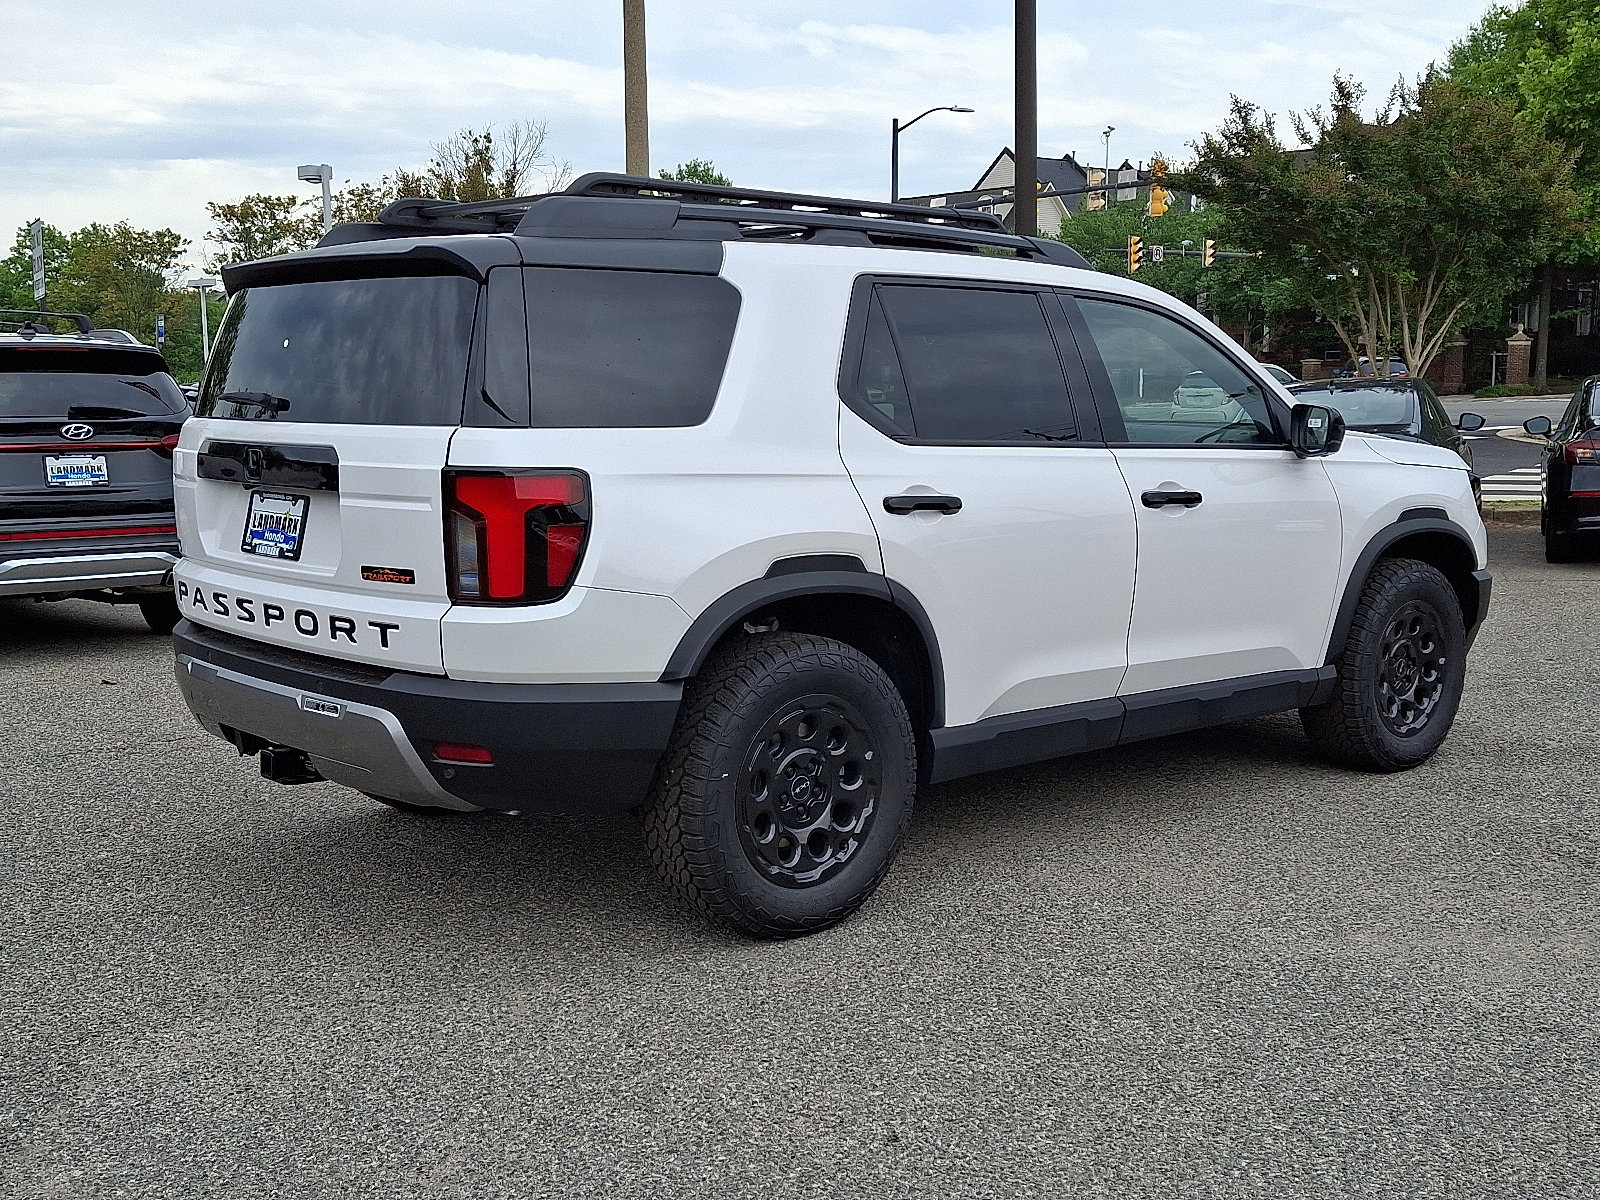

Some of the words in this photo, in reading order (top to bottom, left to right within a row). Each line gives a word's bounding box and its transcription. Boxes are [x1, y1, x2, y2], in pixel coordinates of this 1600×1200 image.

[50, 464, 104, 475] LANDMARK
[252, 511, 300, 535] LANDMARK
[263, 530, 285, 543] Honda
[363, 572, 412, 583] TRAILSPORT
[178, 581, 400, 649] PASSPORT
